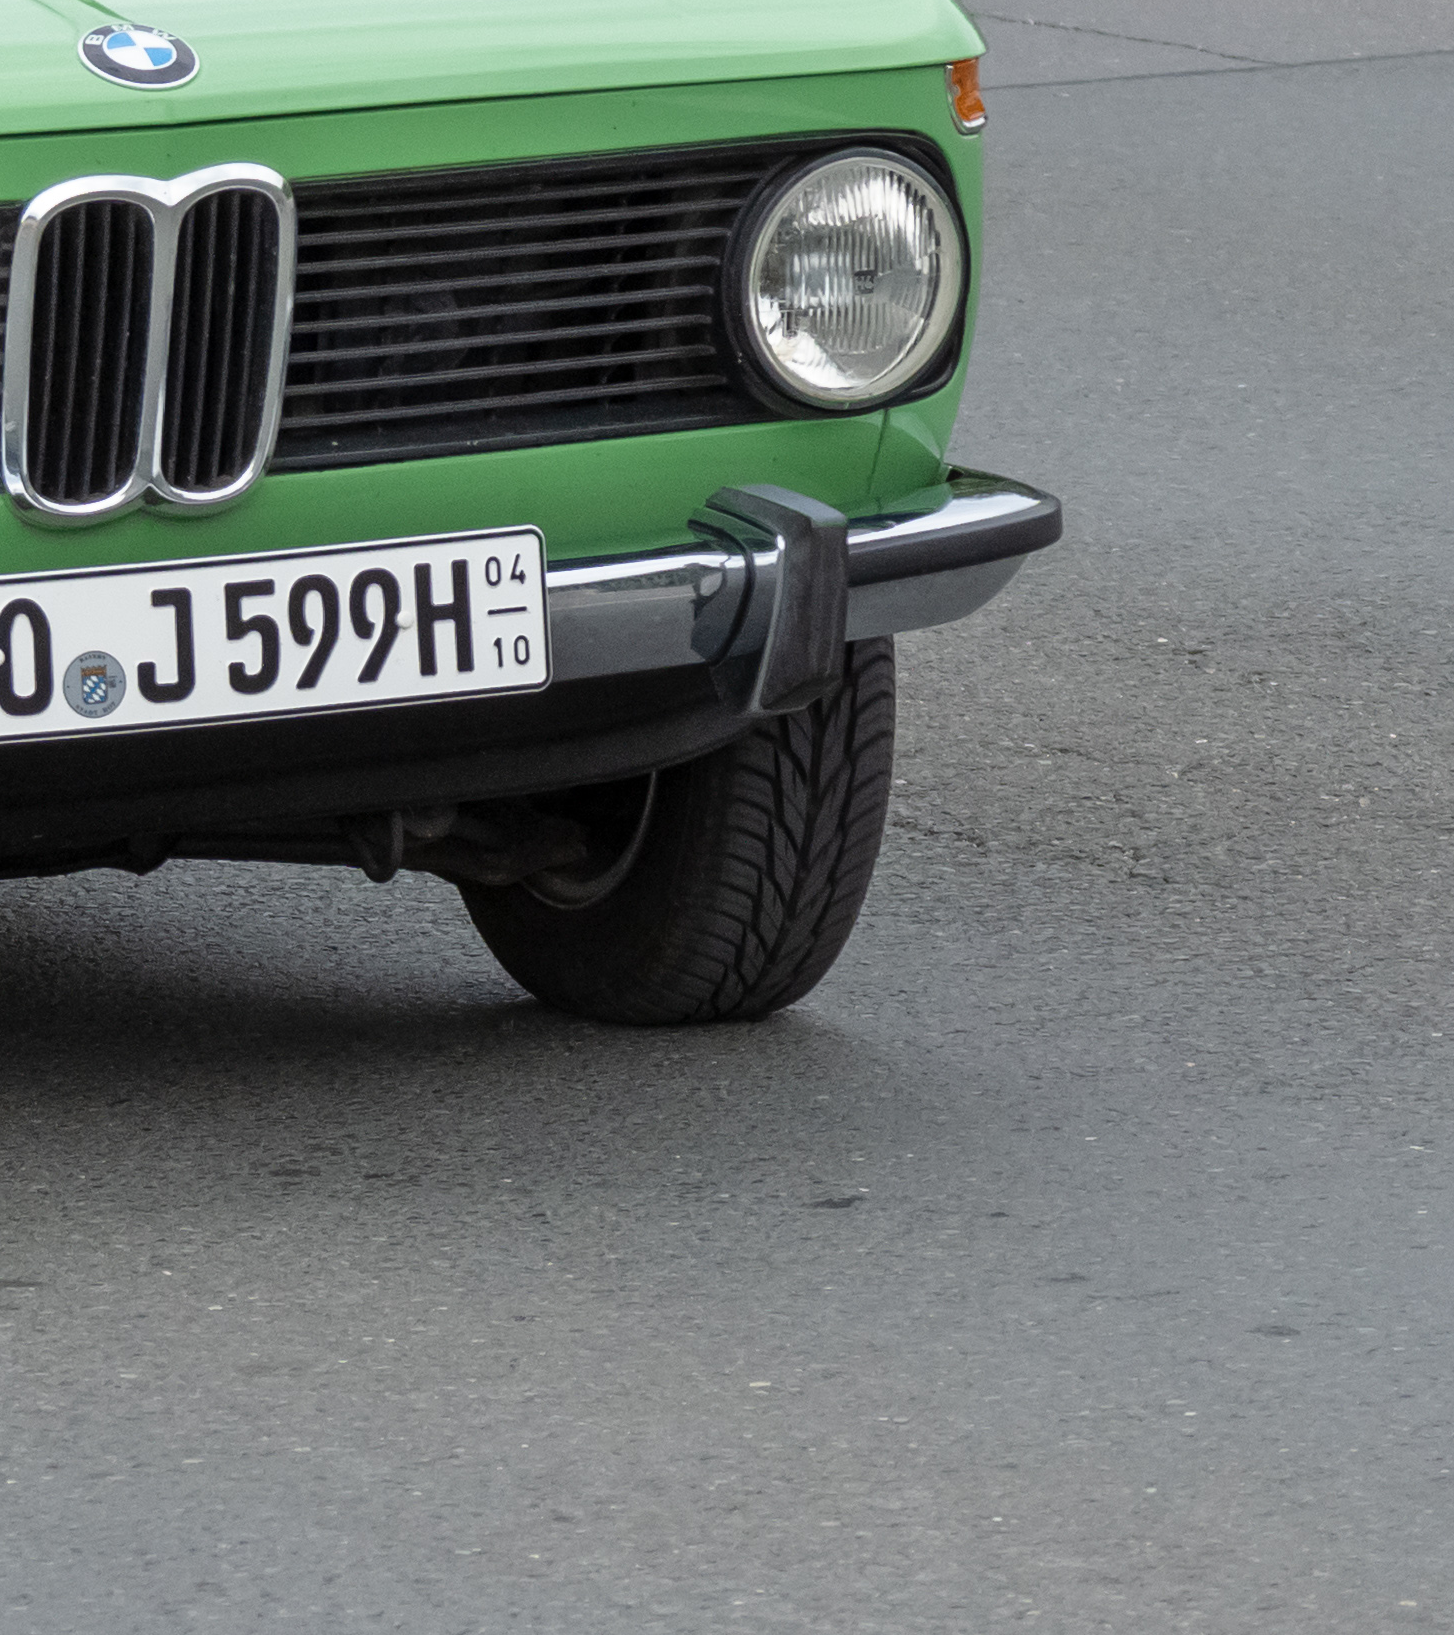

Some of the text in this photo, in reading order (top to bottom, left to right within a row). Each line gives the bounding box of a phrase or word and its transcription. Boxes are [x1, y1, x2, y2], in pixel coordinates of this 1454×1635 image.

[84, 23, 177, 46] BMW
[485, 553, 526, 586] 04
[137, 587, 196, 704] J
[224, 559, 475, 695] 599H
[493, 635, 530, 667] 10
